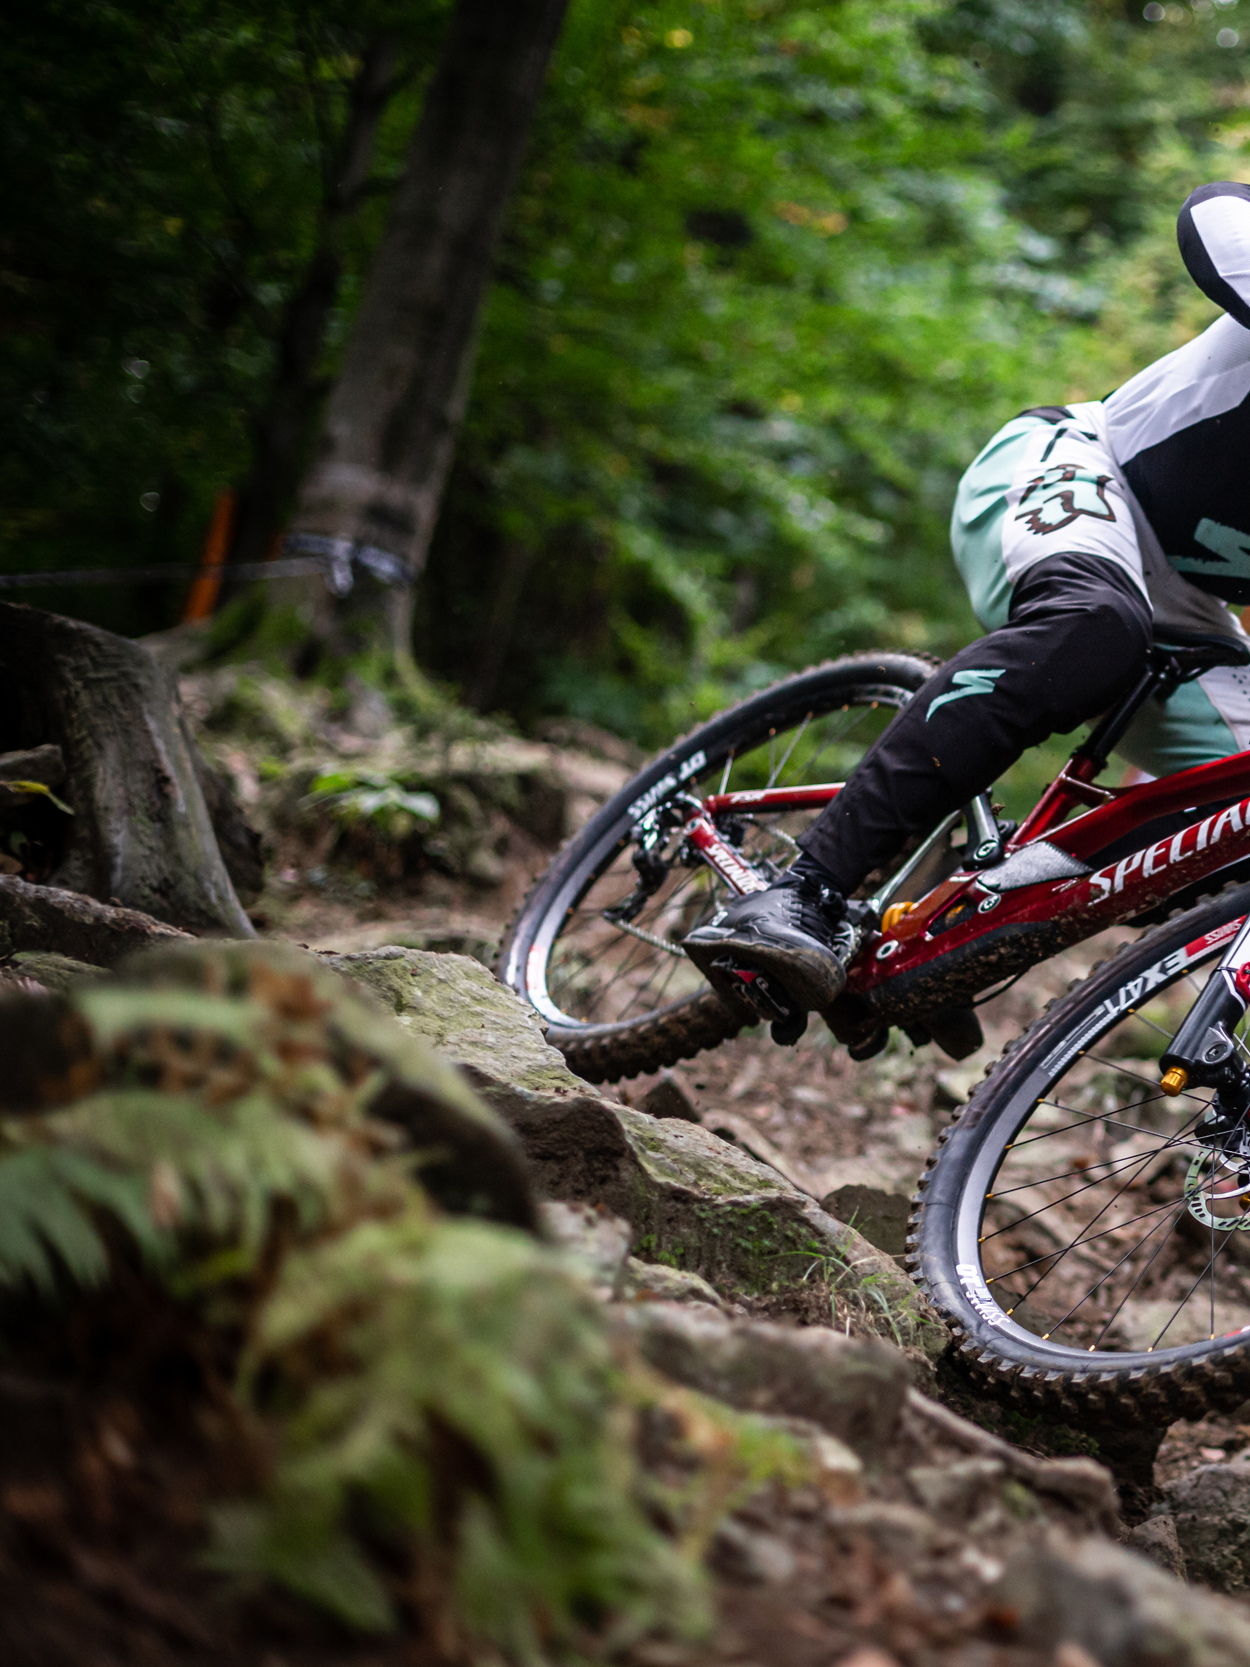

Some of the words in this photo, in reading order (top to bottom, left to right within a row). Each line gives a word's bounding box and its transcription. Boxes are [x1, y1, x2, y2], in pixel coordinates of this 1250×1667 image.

[1103, 947, 1189, 1017] EX471
[955, 1263, 983, 1288] DT
[965, 1290, 1011, 1326] SWISS
